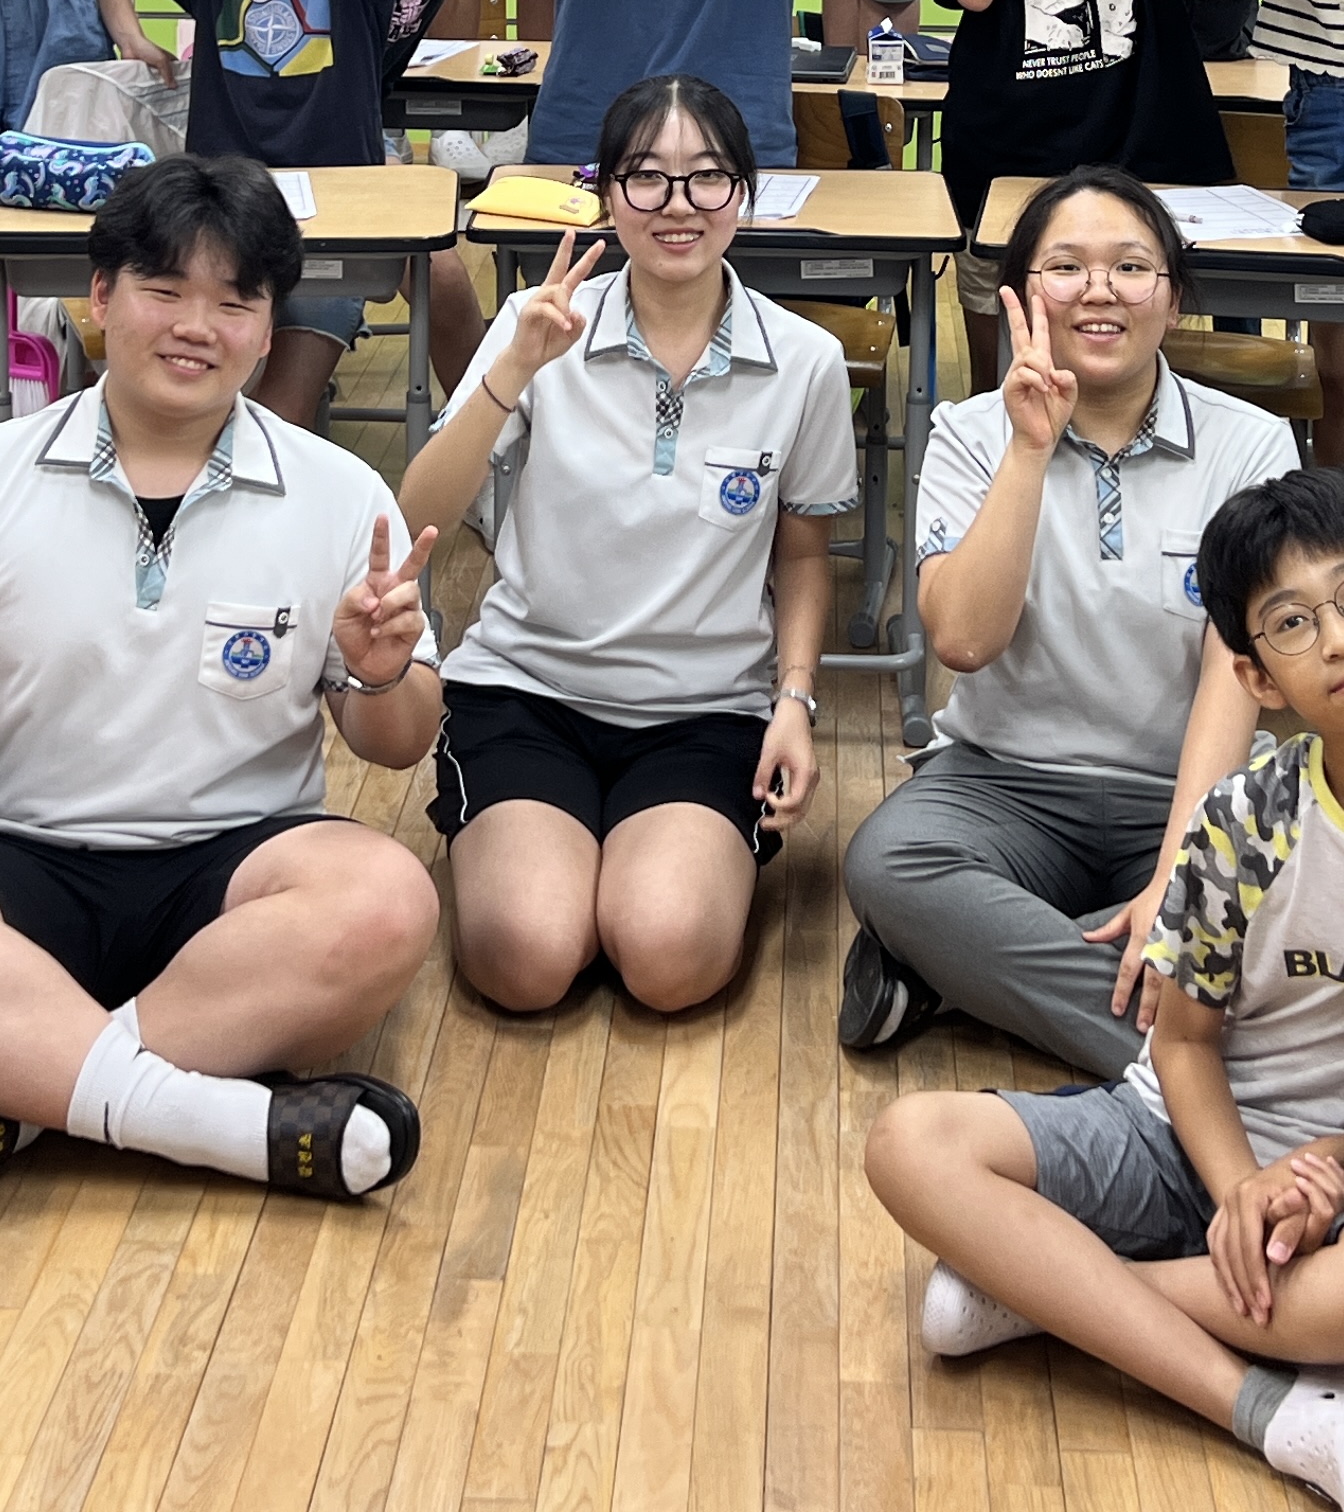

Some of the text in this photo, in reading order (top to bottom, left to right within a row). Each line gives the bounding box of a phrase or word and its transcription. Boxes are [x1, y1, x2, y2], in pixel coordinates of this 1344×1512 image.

[1022, 49, 1096, 68] NEVER TRUST PEOPLE
[1068, 63, 1084, 75] LIKE
[1084, 58, 1104, 71] CATS
